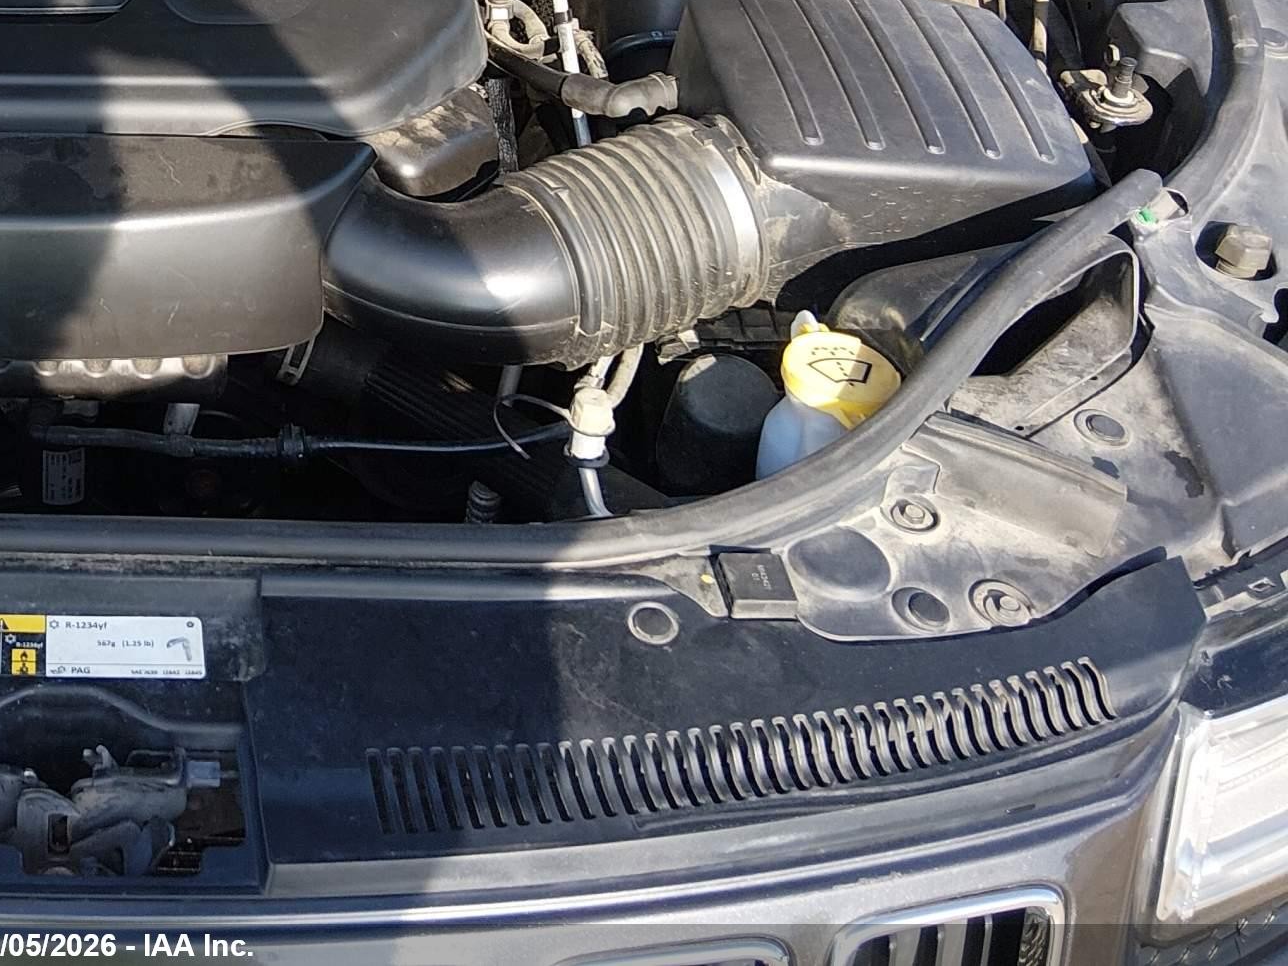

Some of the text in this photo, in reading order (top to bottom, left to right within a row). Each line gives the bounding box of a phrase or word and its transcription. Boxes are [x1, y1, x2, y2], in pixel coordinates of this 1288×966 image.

[65, 620, 108, 632] R-1234yf
[122, 639, 142, 649] (1.25
[70, 665, 91, 675] PAG
